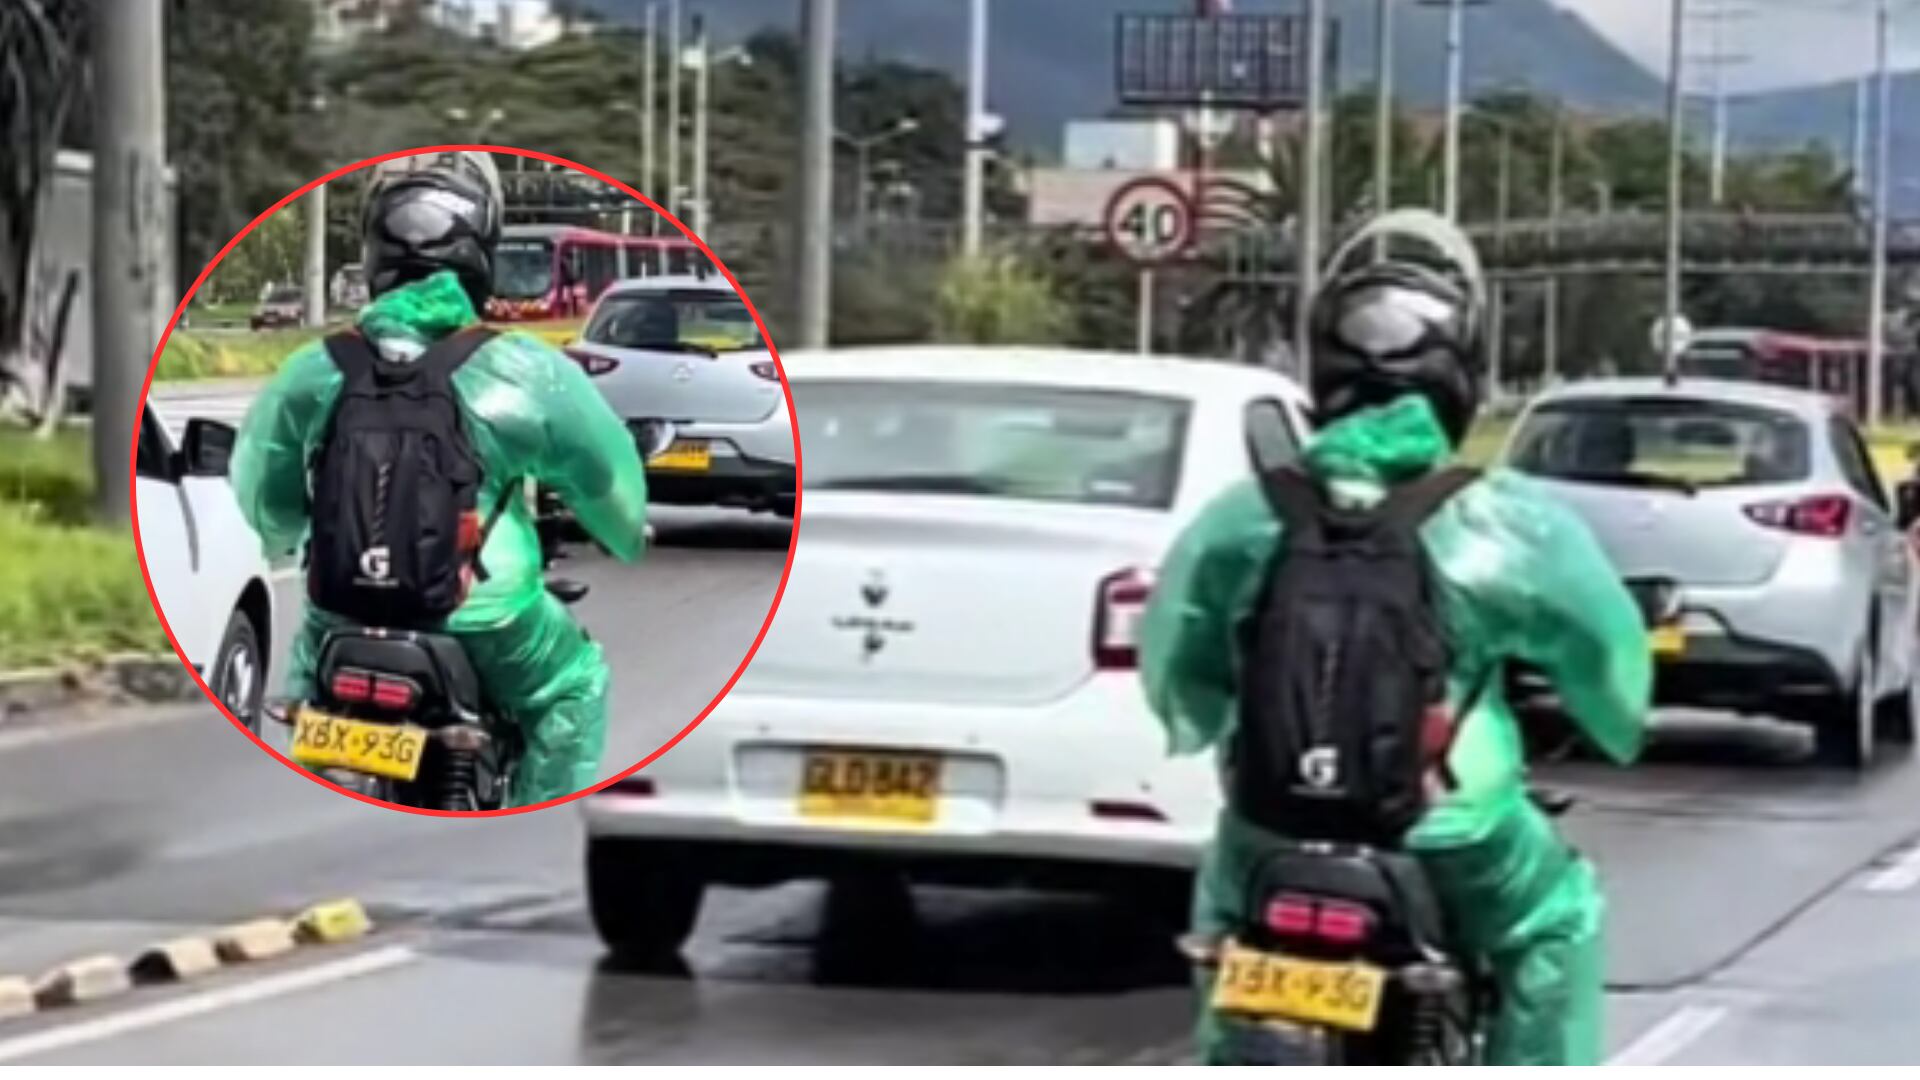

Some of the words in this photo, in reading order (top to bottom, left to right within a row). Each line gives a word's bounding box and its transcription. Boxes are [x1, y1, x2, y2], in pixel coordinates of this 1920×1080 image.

[1118, 202, 1178, 244] 40
[360, 547, 390, 579] G
[1300, 746, 1338, 786] G
